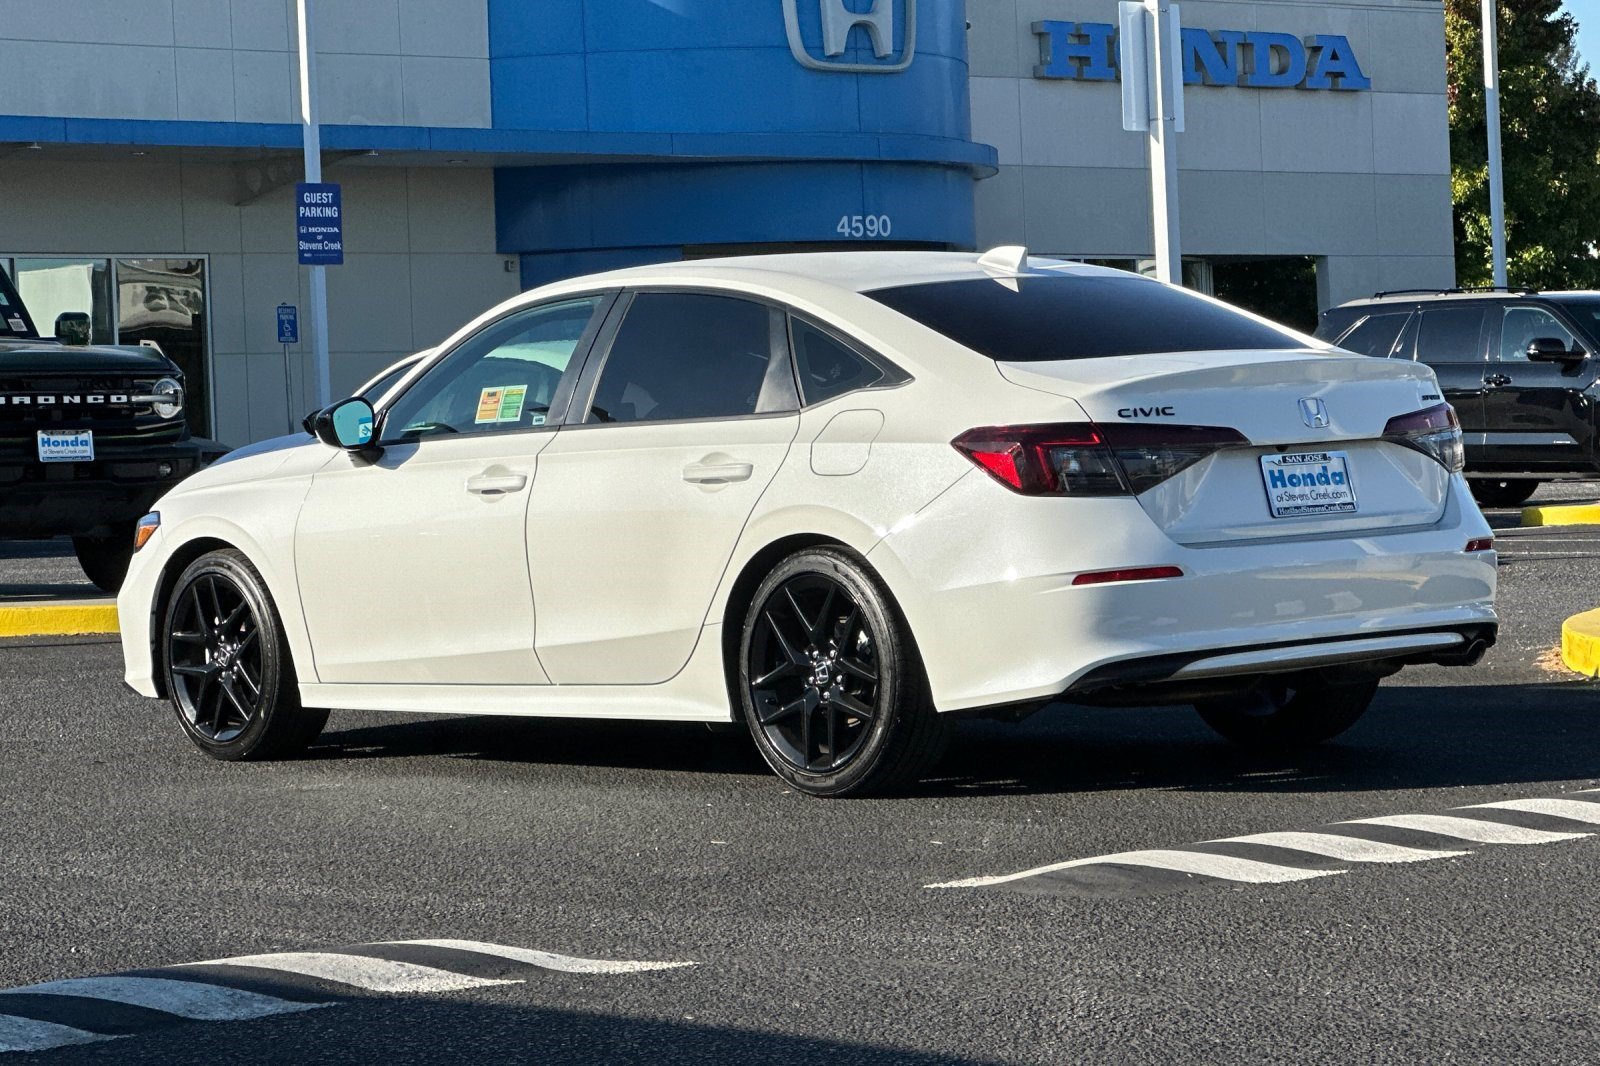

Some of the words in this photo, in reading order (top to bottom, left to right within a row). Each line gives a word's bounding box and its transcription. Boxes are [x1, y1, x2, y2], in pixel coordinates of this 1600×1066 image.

[1034, 20, 1372, 90] HNDA
[303, 192, 333, 204] GUEST
[299, 206, 339, 218] PARKING
[836, 214, 892, 238] 4590
[299, 240, 322, 250] Stevens
[323, 240, 342, 250] Creek
[1117, 406, 1176, 418] CIVIC
[41, 436, 89, 448] Honda
[1285, 455, 1302, 463] SAN
[1303, 453, 1325, 462] JOSE
[1268, 465, 1345, 489] Honda
[1276, 492, 1284, 503] of
